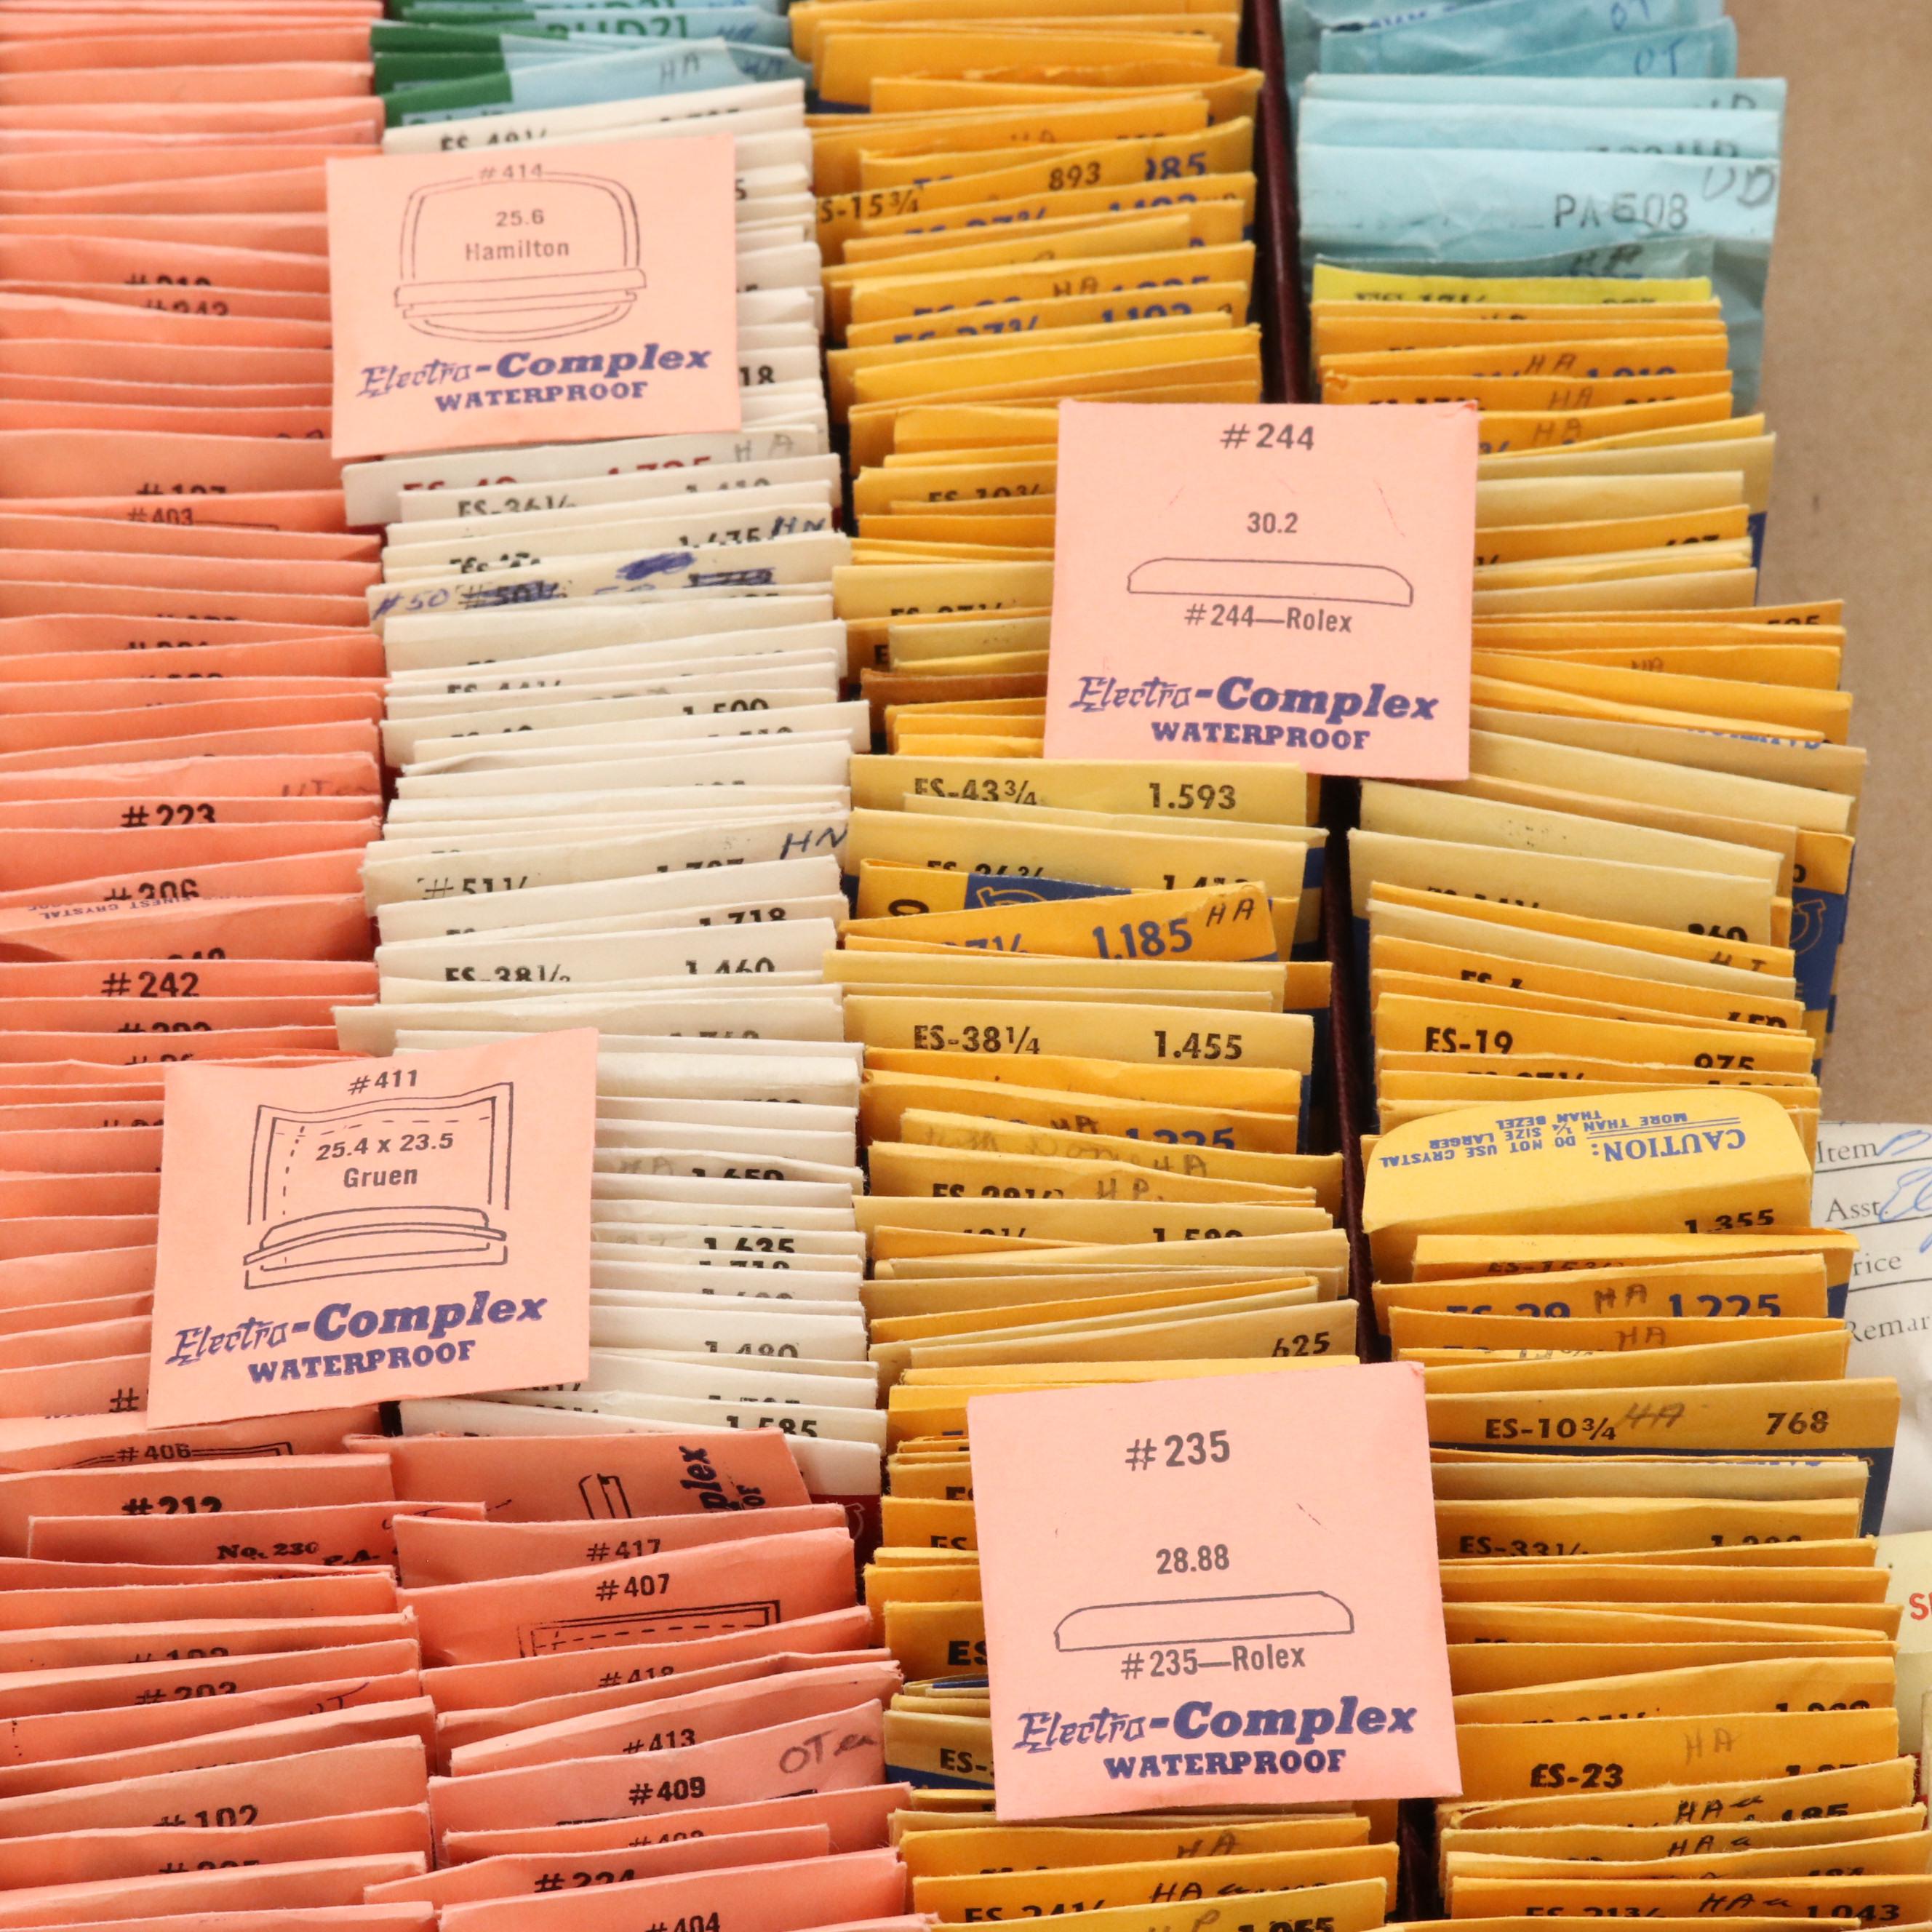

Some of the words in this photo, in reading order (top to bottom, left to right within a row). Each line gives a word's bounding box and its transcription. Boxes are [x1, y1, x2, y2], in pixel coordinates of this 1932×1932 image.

[480, 164, 543, 180] #414
[1048, 161, 1103, 192] 893
[495, 209, 545, 227] 25.6
[466, 241, 570, 263] Hamilton
[356, 343, 711, 397] Electro-Complex
[435, 382, 647, 412] WATERPROOF
[1219, 422, 1315, 451] #244
[1247, 512, 1298, 534] 30.2
[1068, 676, 1440, 725] Electro-Complex
[1151, 721, 1371, 750] WATERPROOF
[1149, 783, 1237, 810] 1.593
[699, 907, 788, 927] 1718
[1205, 896, 1257, 928] HA
[1091, 917, 1194, 961] 1.185
[685, 957, 776, 975] 1460
[100, 970, 201, 998] #242
[913, 1024, 1042, 1056] ES-38¼
[1152, 1029, 1245, 1061] 1.455
[1424, 1026, 1515, 1055] ES-19
[348, 1069, 418, 1094] #411
[1495, 1115, 1546, 1130] BEZEL
[1556, 1109, 1602, 1124] THAN
[1582, 1118, 1629, 1133] THAN
[1640, 1113, 1688, 1127] MORE
[316, 1137, 369, 1162] 25.4
[378, 1138, 390, 1153] x
[399, 1132, 454, 1151] 23.5
[1125, 1127, 1235, 1151] 225
[1428, 1132, 1495, 1149] LARGER
[1504, 1127, 1542, 1142] SIZE
[1509, 1139, 1543, 1154] NOT
[1554, 1135, 1576, 1149] DO
[1591, 1127, 1747, 1162] CAUTION:
[1378, 1148, 1456, 1168] CRYSTAL
[1466, 1144, 1498, 1157] USE
[1816, 1141, 1880, 1164] Item
[343, 1168, 418, 1189] Gruen
[1685, 1208, 1775, 1234] 1355
[703, 1237, 796, 1254] 1635
[1667, 1293, 1783, 1318] 1225
[165, 1290, 548, 1365] Electro-Complex
[1271, 1330, 1332, 1358] 625
[247, 1339, 476, 1384] WATERPROOF
[725, 1415, 819, 1438] 1585
[1485, 1417, 1617, 1442] ES-10¾
[1765, 1408, 1830, 1437] 768
[116, 1442, 192, 1463] #406
[1125, 1429, 1231, 1471] #235
[586, 1538, 663, 1562] #417
[1156, 1544, 1229, 1576] 28.88
[595, 1572, 672, 1603] #407
[1908, 1591, 1932, 1622] S
[1013, 1696, 1418, 1754] Electro-Complex
[623, 1728, 698, 1755] #413
[939, 1747, 995, 1773] ES-
[1103, 1748, 1346, 1779] WATERPROOF
[1529, 1762, 1625, 1790] ES-23
[628, 1776, 708, 1806] #409
[1807, 1903, 1901, 1922] 1043
